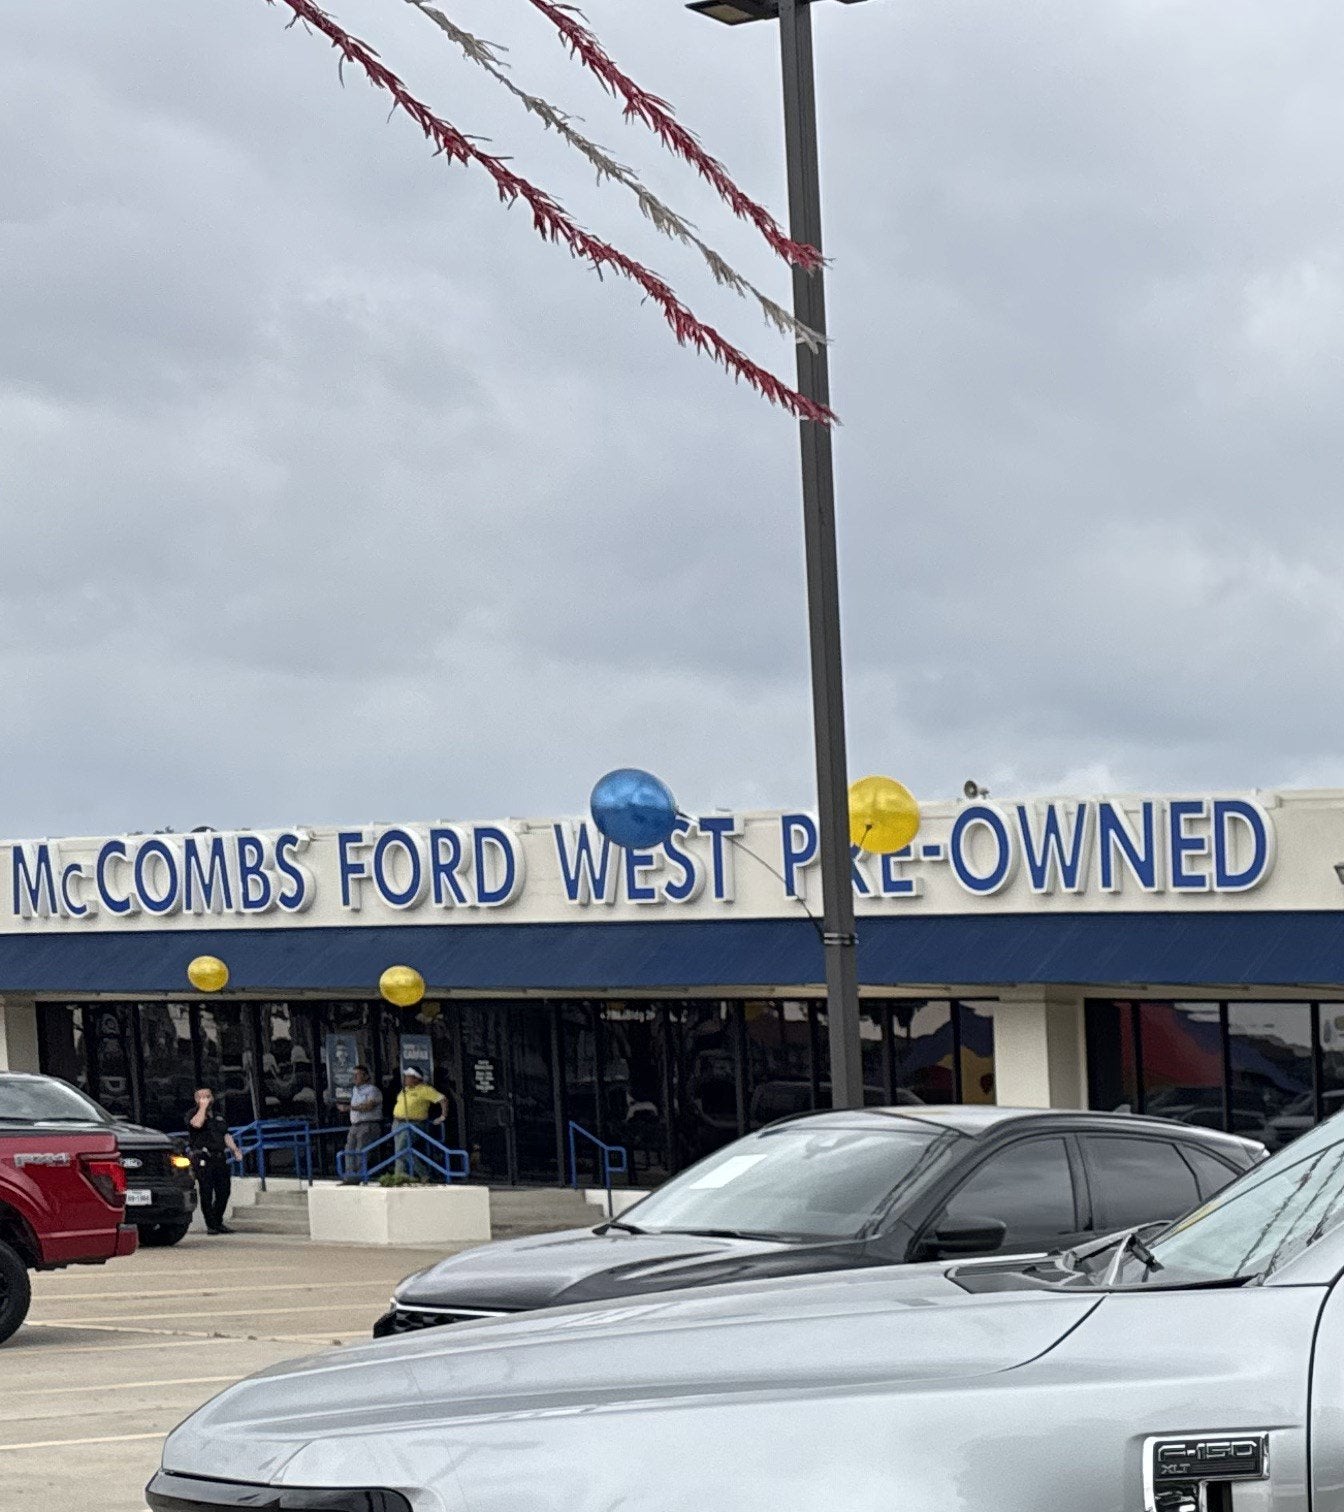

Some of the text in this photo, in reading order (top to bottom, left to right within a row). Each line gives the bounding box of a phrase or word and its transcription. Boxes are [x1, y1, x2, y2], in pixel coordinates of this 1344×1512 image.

[338, 827, 517, 906] FORD
[553, 816, 736, 902] WEST
[1158, 1440, 1257, 1462] F-150
[1161, 1463, 1190, 1474] XLT
